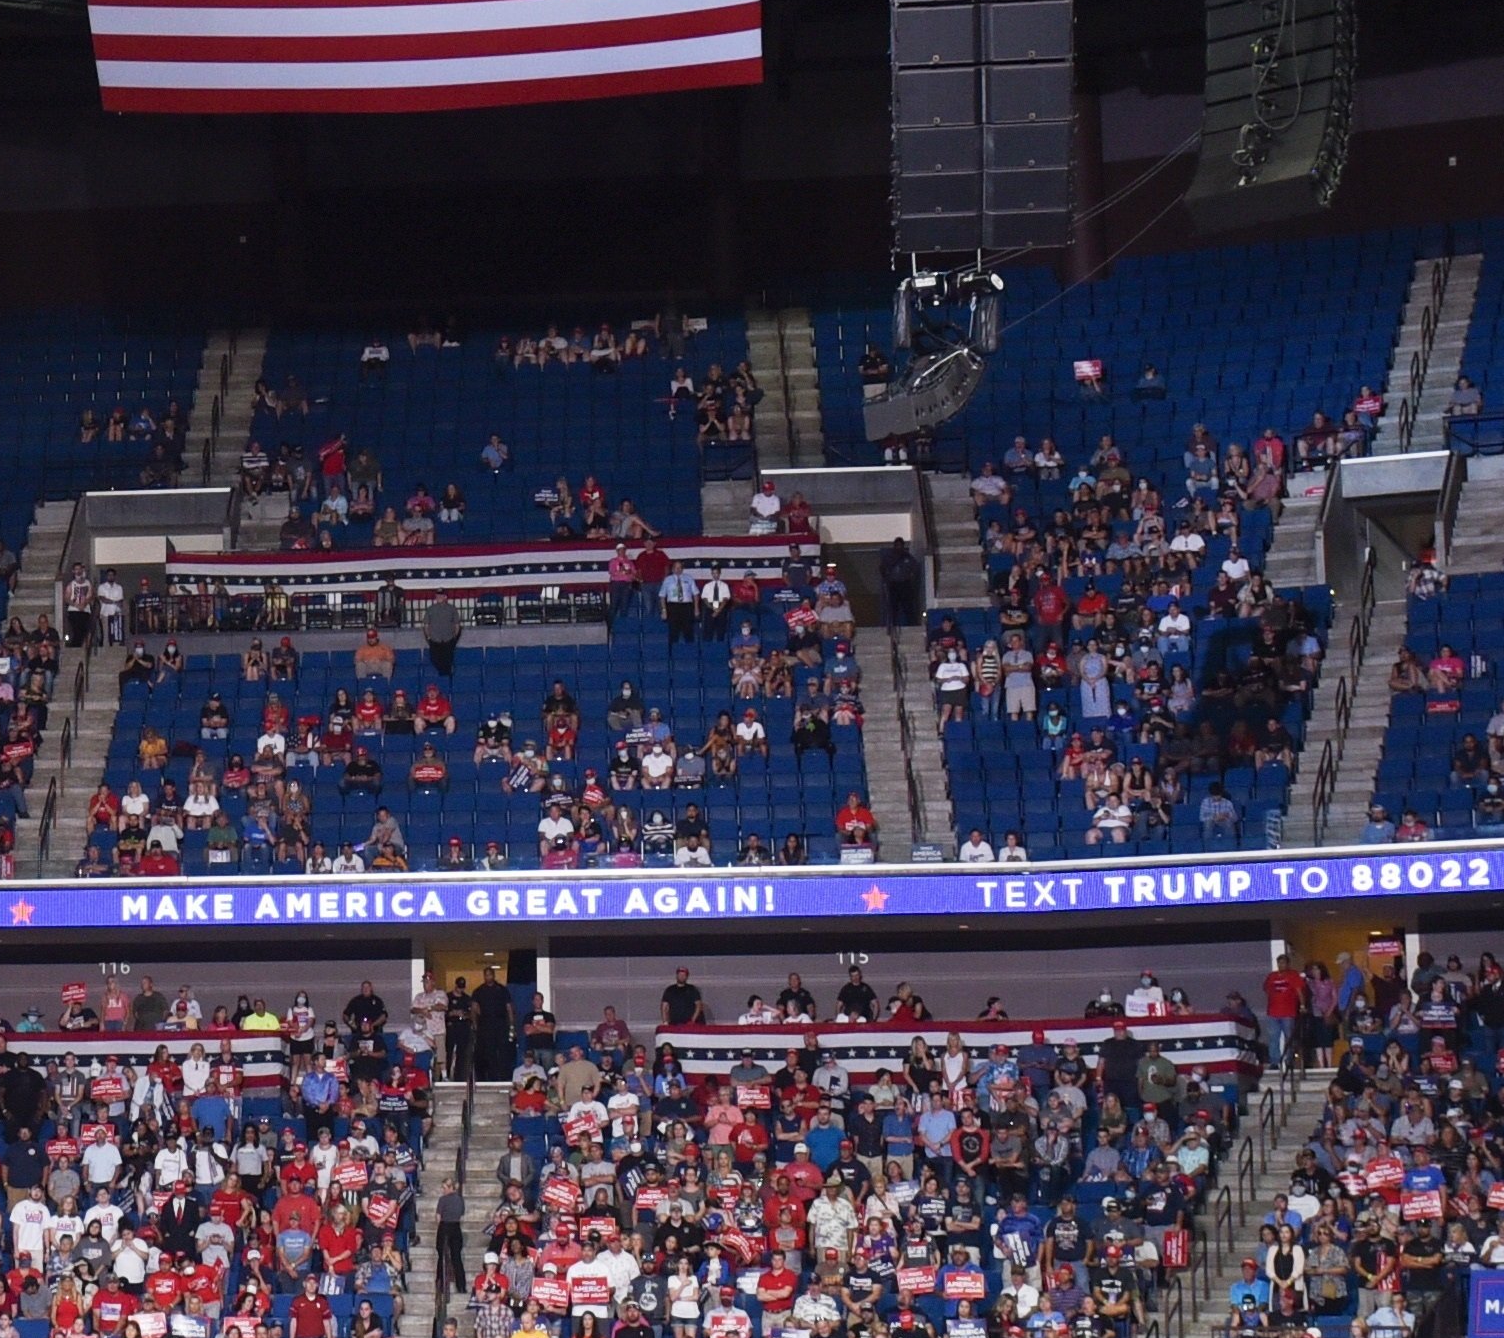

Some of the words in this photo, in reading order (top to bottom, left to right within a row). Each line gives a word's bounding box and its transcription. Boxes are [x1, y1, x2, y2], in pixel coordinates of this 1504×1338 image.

[975, 878, 1083, 908] TEXT
[1103, 870, 1251, 904] TRUMP
[1272, 866, 1329, 895] TO
[1351, 857, 1490, 892] 88022
[122, 893, 234, 921] MAKE
[254, 890, 445, 920] AMERICA
[466, 887, 603, 917] GREAT
[623, 884, 775, 914] AGAIN!
[836, 952, 869, 965] 115
[99, 962, 130, 974] 116
[638, 1193, 670, 1202] AMERICA
[1404, 1198, 1439, 1210] AMERICA
[581, 1225, 614, 1233] AMERICA
[900, 1276, 934, 1286] AMERICA
[947, 1281, 983, 1289] AMERICA
[534, 1286, 567, 1296] AMERICA
[573, 1285, 607, 1294] AMERICA
[949, 1328, 986, 1337] AMERICA
